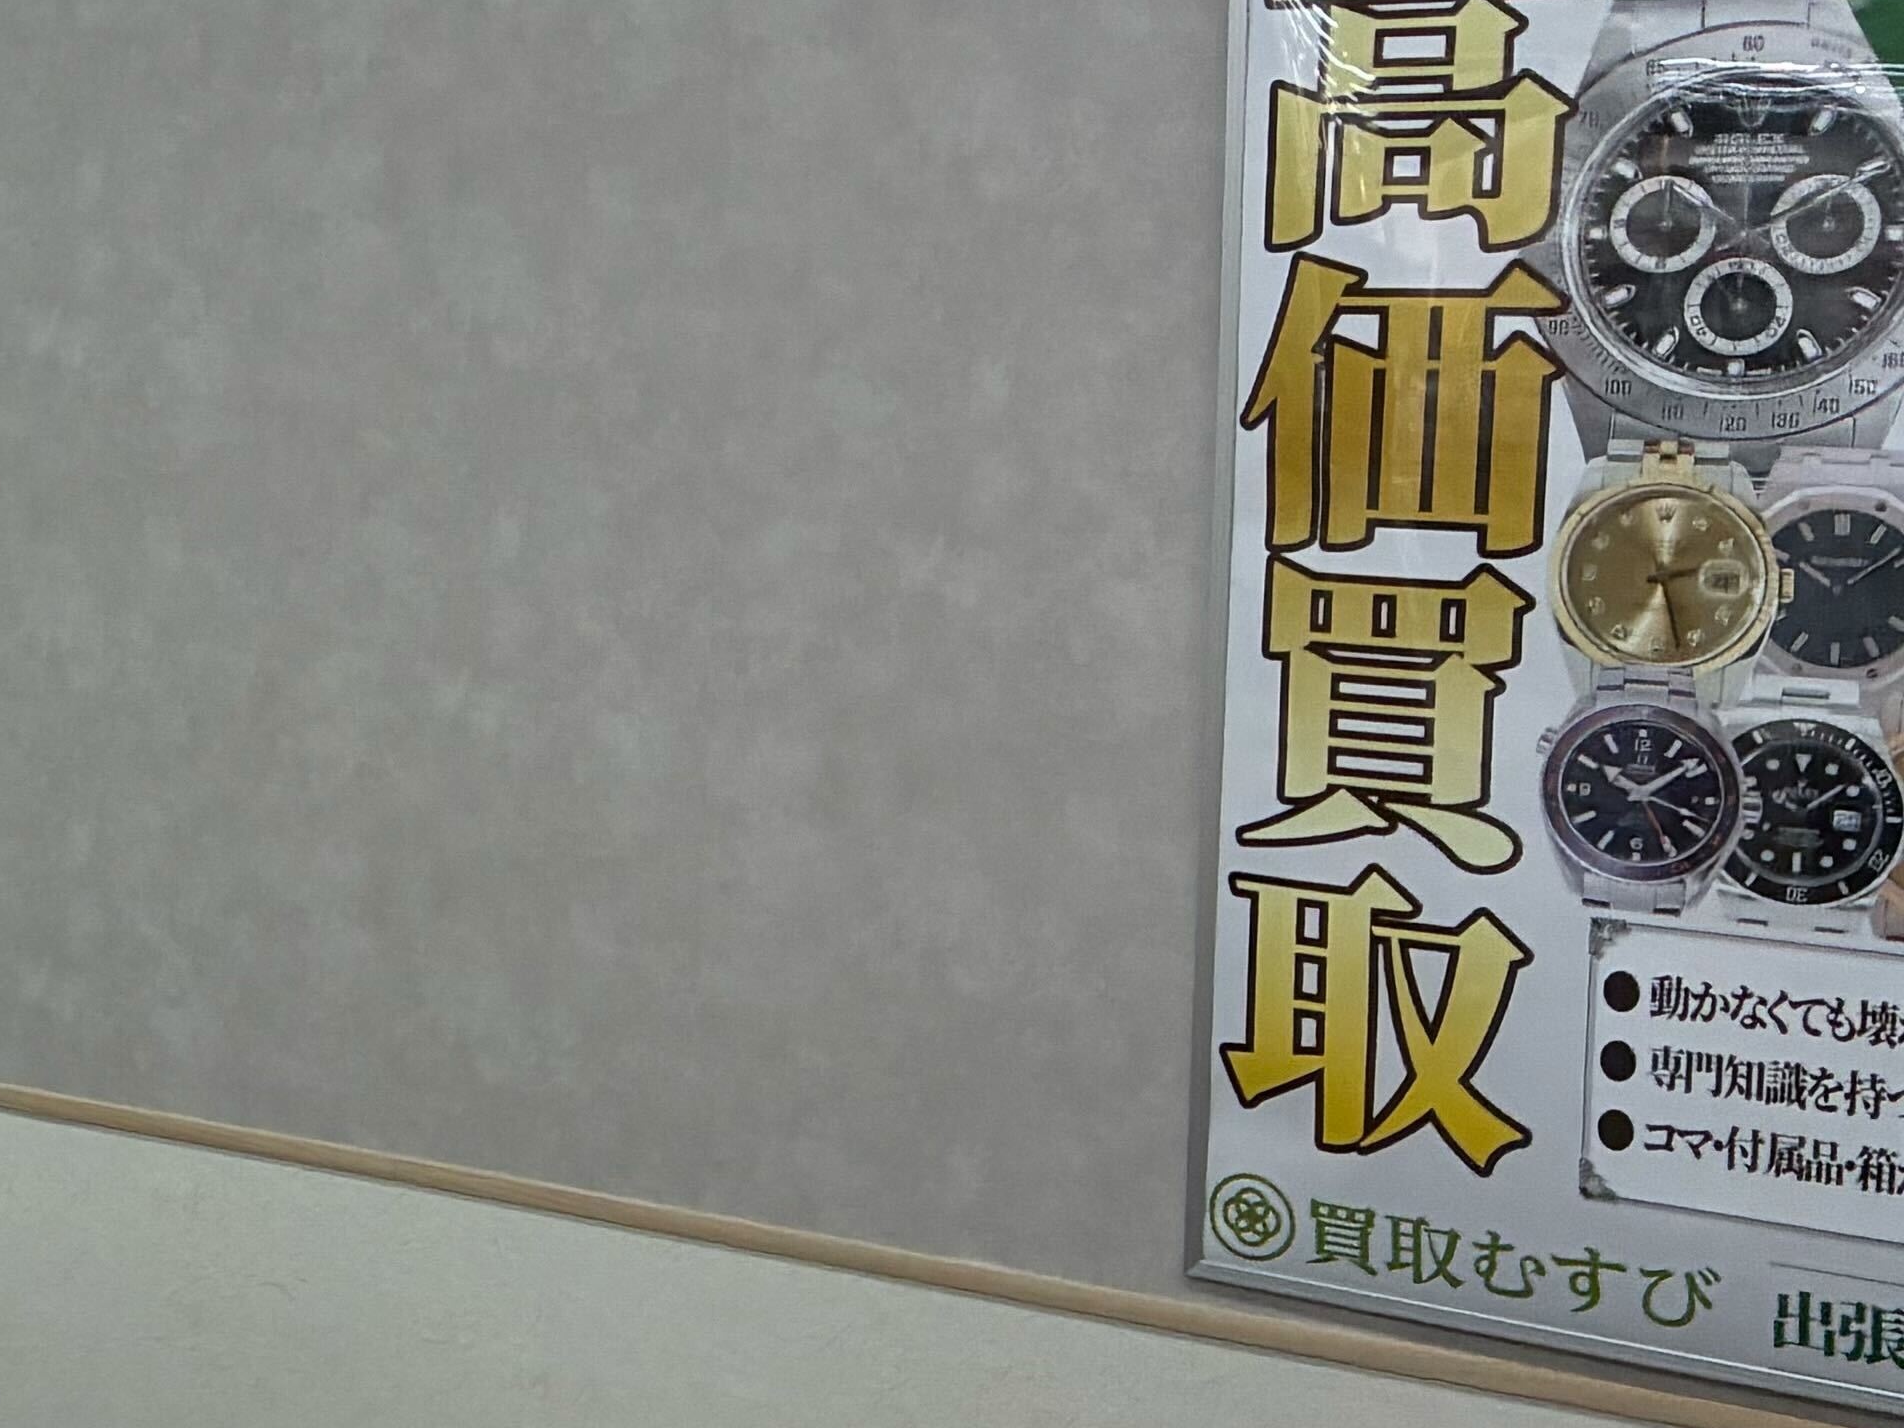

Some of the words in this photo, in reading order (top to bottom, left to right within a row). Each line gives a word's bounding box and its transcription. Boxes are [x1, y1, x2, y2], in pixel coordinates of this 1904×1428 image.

[1649, 974, 1904, 1049] 動かなくても壊
[1644, 1123, 1904, 1196] コマ・付属品・箱
[1306, 1198, 1721, 1328] 買取むすび
